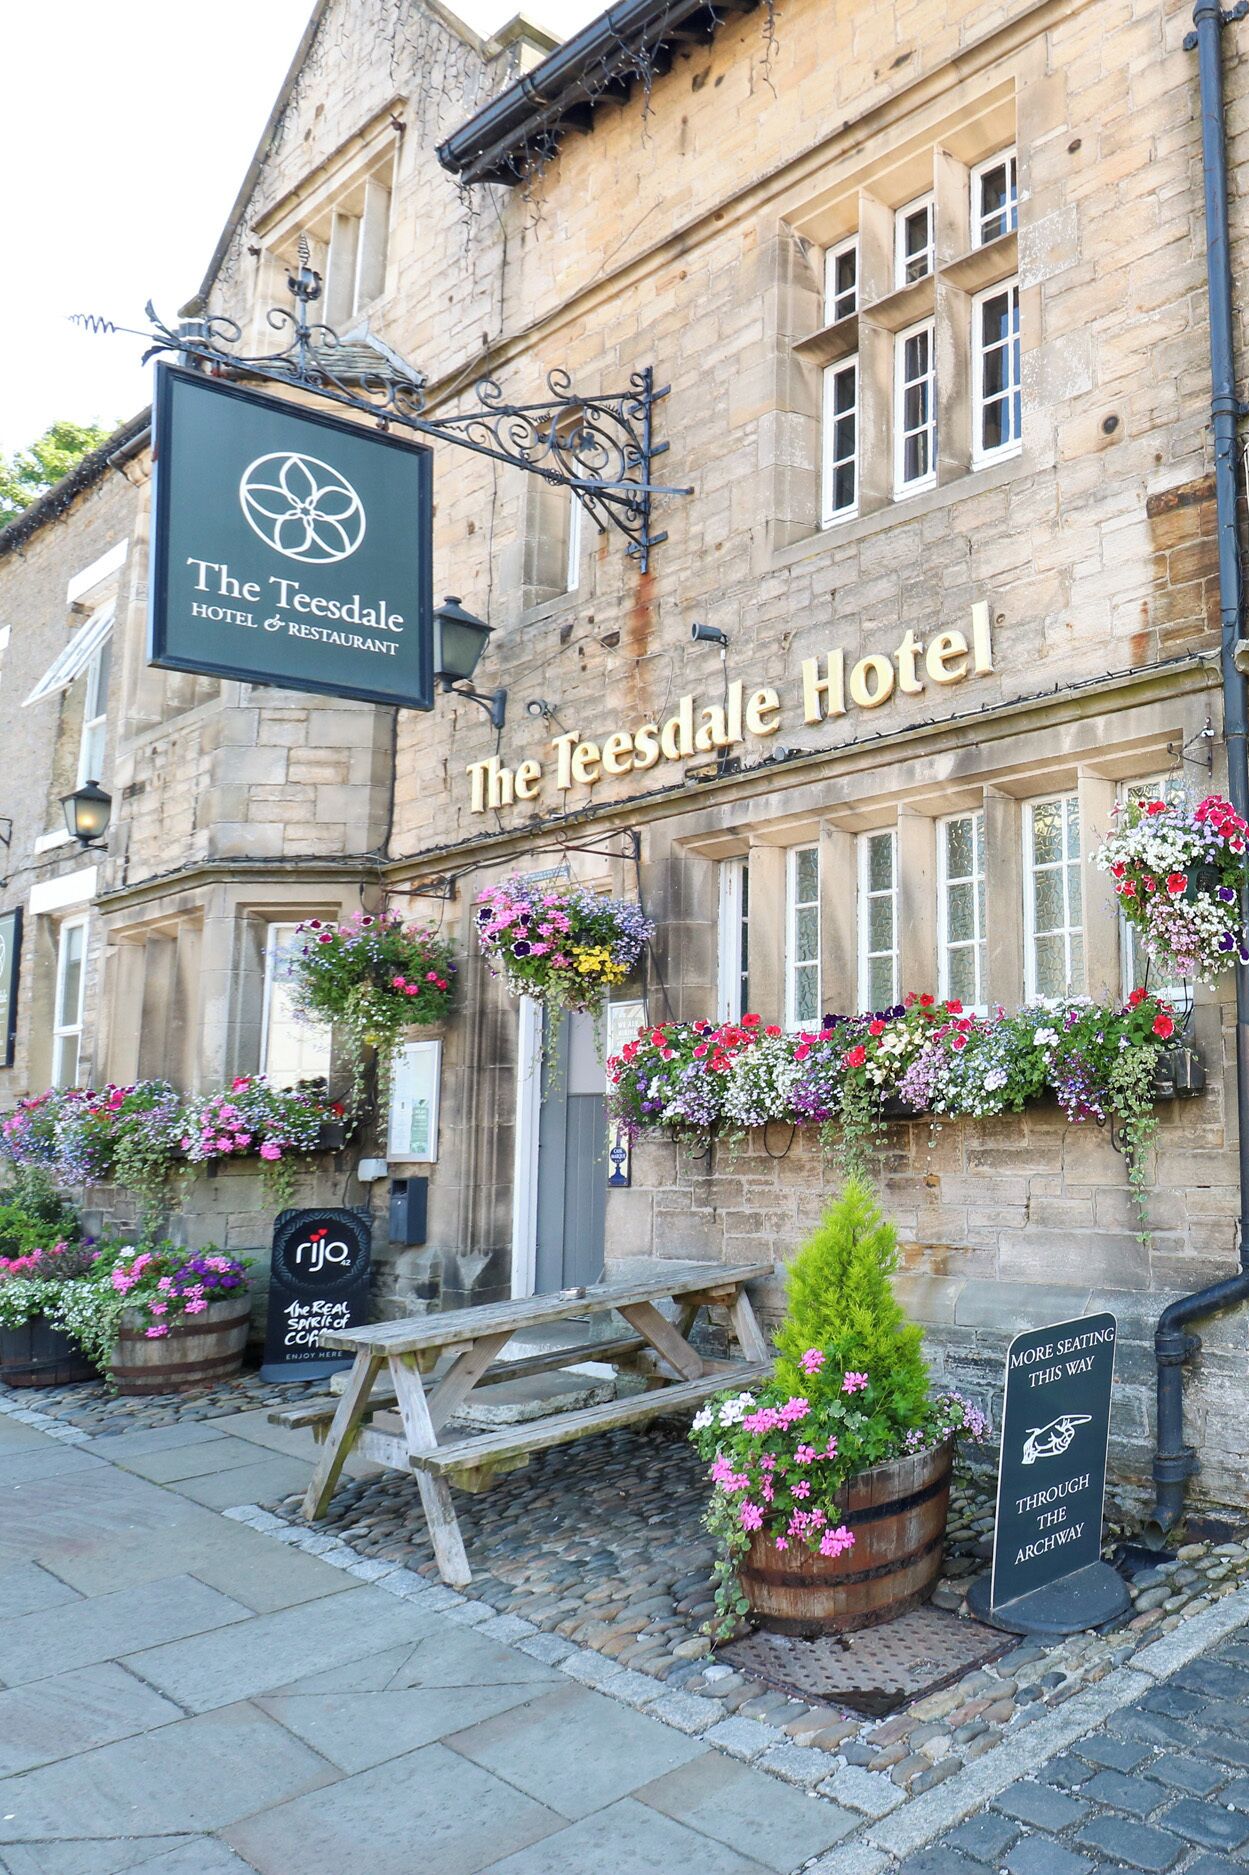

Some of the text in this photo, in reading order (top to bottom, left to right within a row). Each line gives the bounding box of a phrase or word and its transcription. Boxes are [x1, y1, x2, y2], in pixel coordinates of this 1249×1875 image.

[187, 557, 404, 632] The Teesdale
[192, 602, 398, 656] HOTEL & RESTAURANT
[466, 600, 995, 814] The Teesdale Hotel
[296, 1231, 349, 1272] rijo
[284, 1300, 350, 1317] The REAL
[333, 1313, 350, 1328] of
[1010, 1327, 1115, 1370] MORE SEATING
[1028, 1355, 1095, 1388] THIS WAY
[1015, 1473, 1090, 1515] THROUGH
[1037, 1506, 1067, 1531] THE
[1014, 1522, 1085, 1566] ARCHWAY
